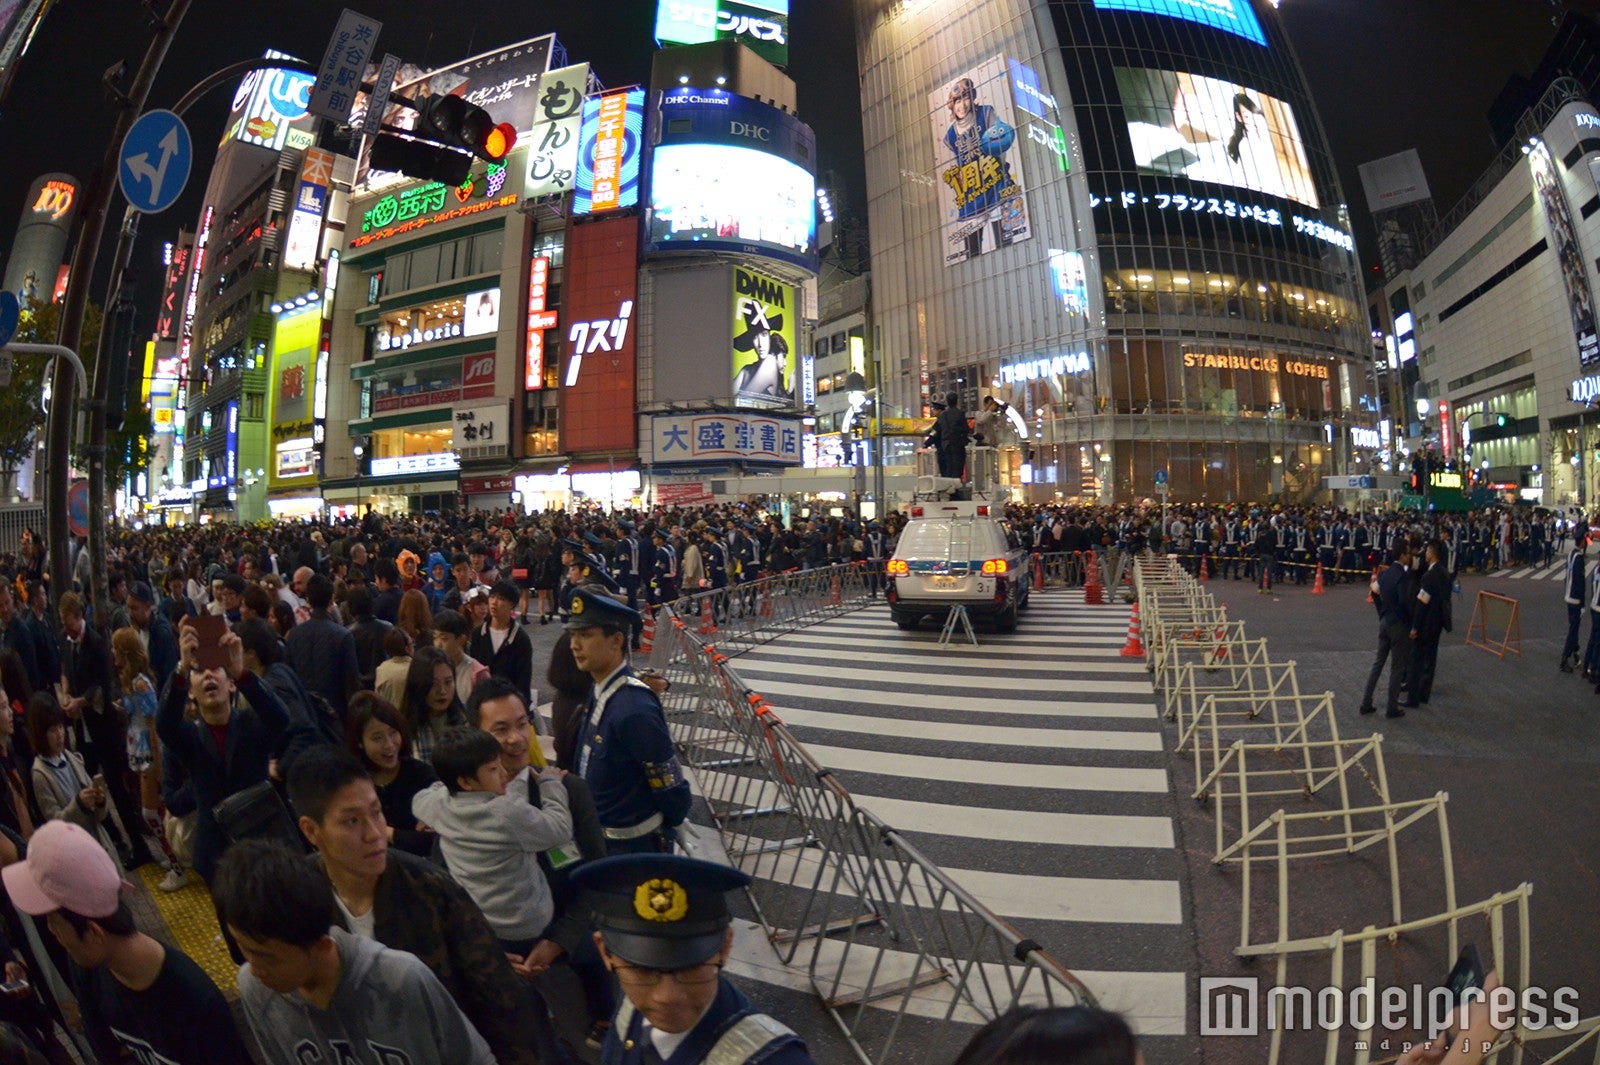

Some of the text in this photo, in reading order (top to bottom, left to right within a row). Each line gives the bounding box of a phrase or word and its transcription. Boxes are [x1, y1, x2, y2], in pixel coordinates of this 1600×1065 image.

[327, 31, 350, 70] Shibuya
[328, 23, 374, 113] 渋谷駅前
[665, 95, 729, 105] DHC Channel
[291, 133, 312, 147] VISA
[530, 80, 583, 188] もんじゃ
[730, 121, 770, 141] DHC
[592, 96, 623, 204] 三千里薬品
[32, 187, 72, 219] 109
[736, 268, 785, 309] DMM
[736, 297, 770, 330] FX
[565, 300, 633, 387] クスリ
[466, 356, 495, 381] JTB
[1000, 351, 1090, 384] TSUTAYA
[1183, 353, 1328, 379] STARBUCKS COFFEE
[662, 421, 796, 453] 大盛堂書店
